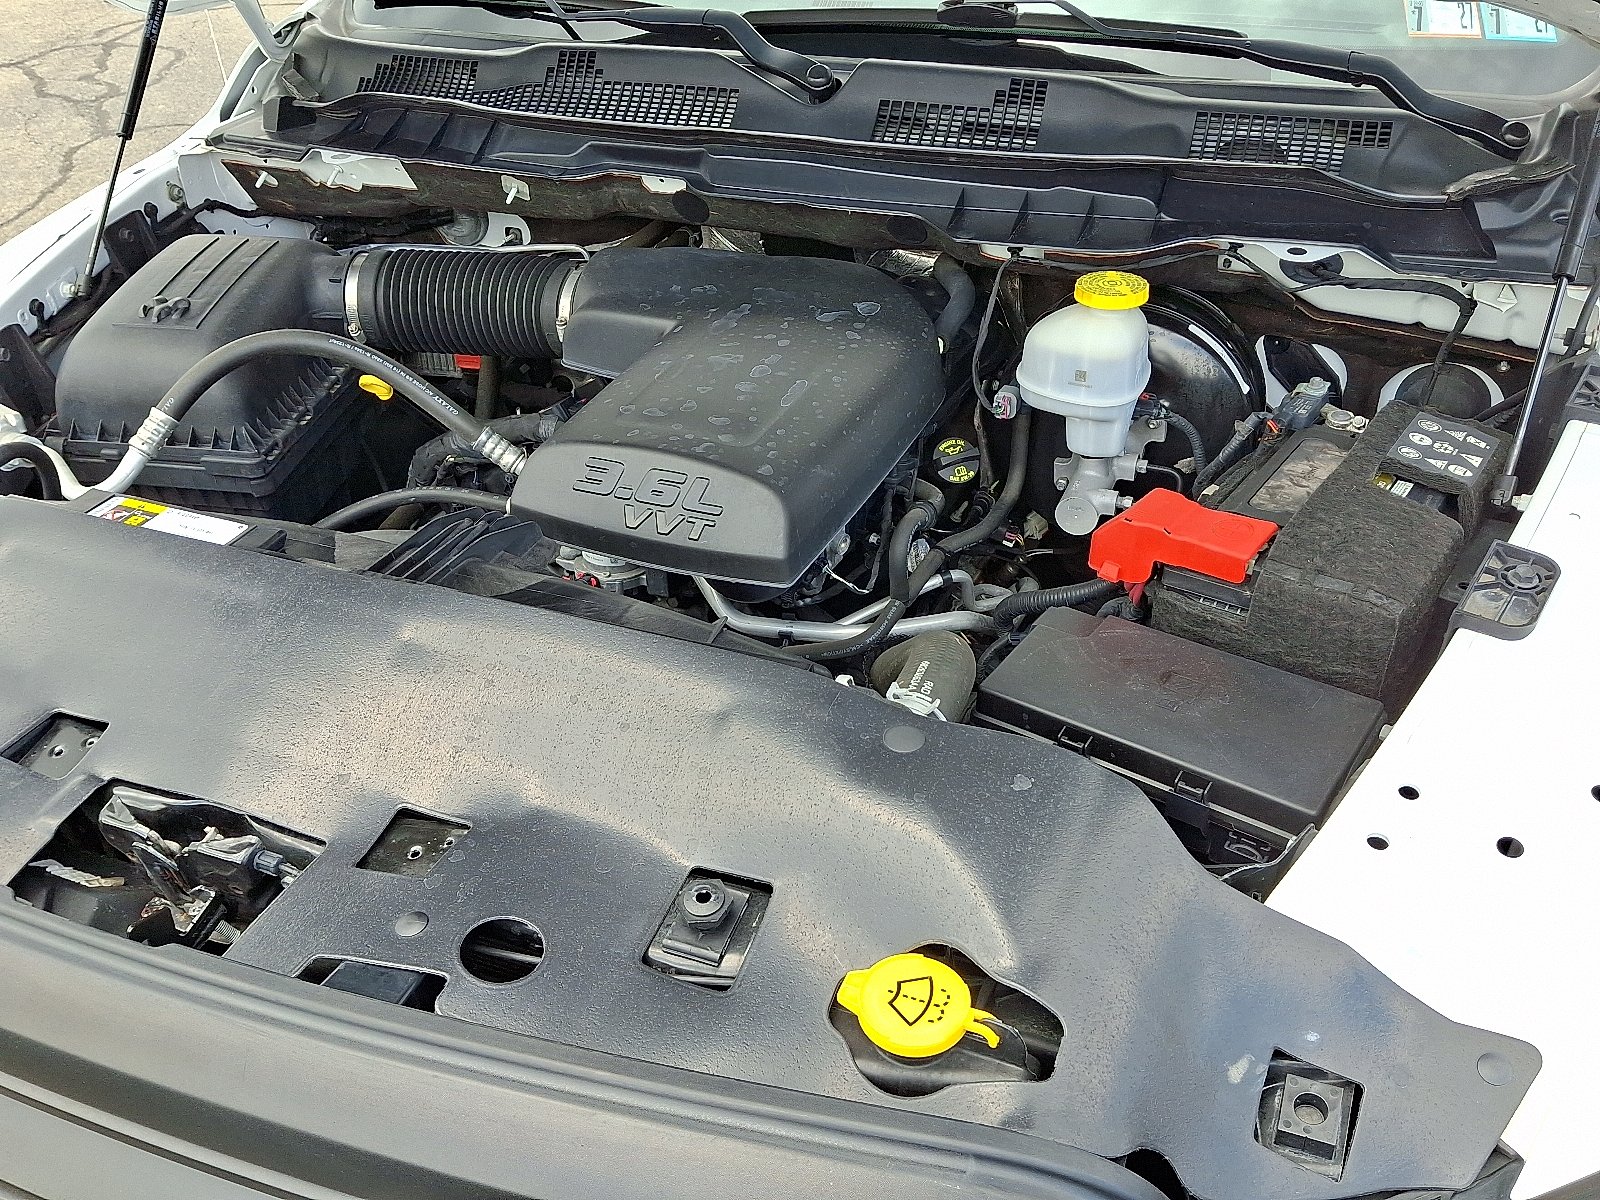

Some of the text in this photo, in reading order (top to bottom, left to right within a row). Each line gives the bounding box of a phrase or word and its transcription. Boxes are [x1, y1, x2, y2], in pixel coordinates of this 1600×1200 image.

[160, 396, 175, 412] GAL
[433, 395, 459, 415] GALAXY
[572, 456, 724, 517] 3.6L
[623, 503, 717, 541] VVT
